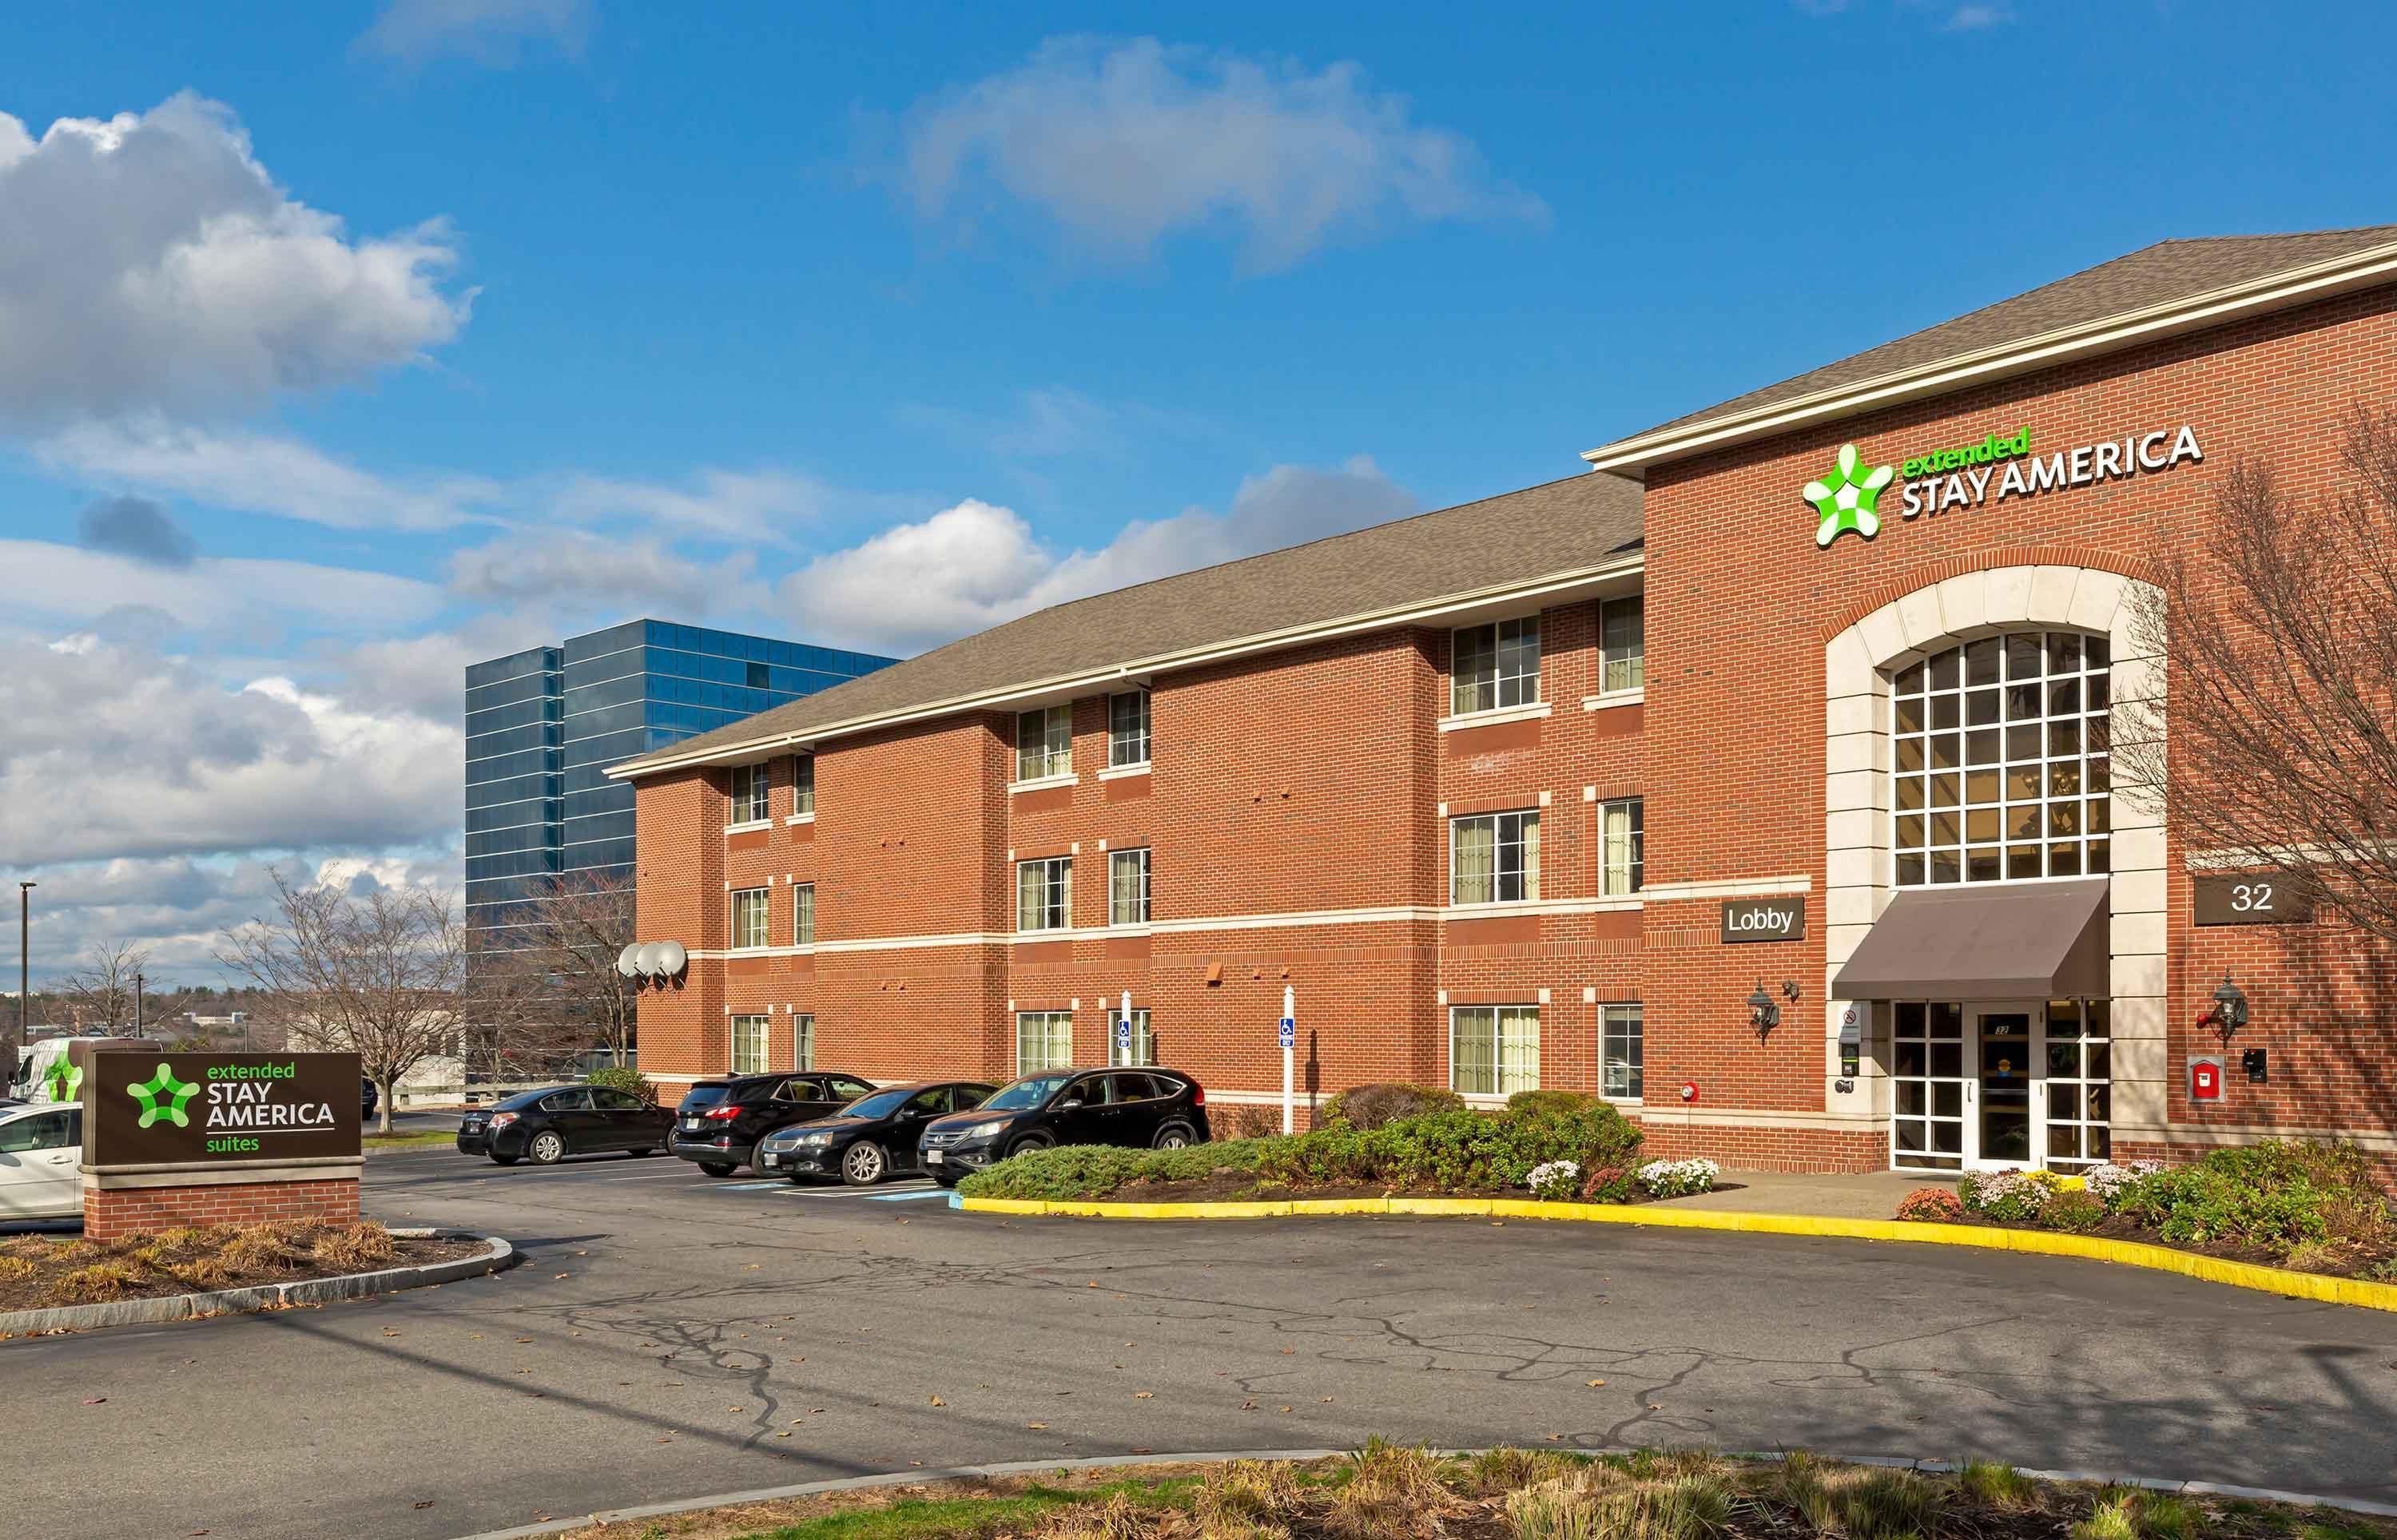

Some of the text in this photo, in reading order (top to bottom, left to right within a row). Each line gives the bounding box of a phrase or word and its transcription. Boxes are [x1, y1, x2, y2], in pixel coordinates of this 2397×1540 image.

[1902, 426, 2030, 478] extended
[1901, 425, 2203, 517] STAY AMERICA
[2231, 883, 2273, 911] 32
[1727, 907, 1794, 934] Lobby
[207, 1062, 295, 1080] extended
[207, 1082, 272, 1105] STAY
[205, 1103, 335, 1127] AMERICA
[206, 1136, 260, 1153] suites
